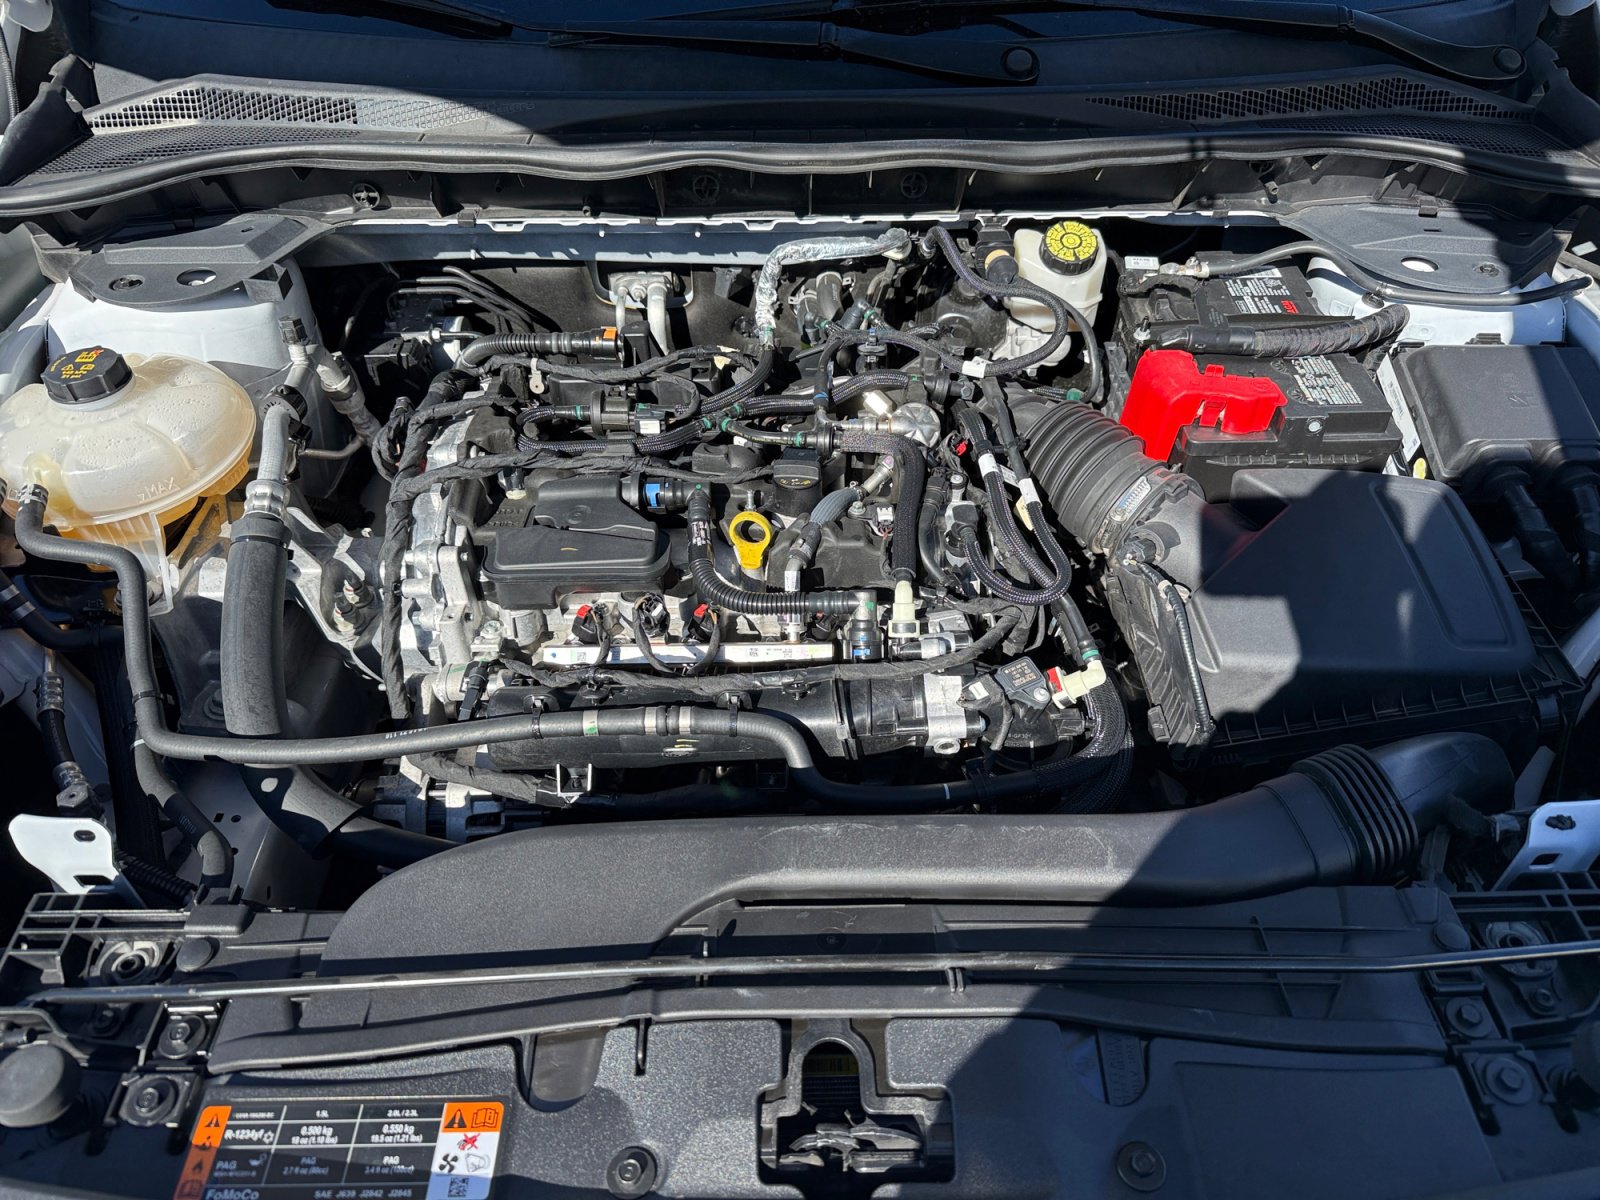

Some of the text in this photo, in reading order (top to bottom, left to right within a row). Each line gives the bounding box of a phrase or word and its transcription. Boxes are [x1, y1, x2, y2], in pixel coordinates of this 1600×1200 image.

[144, 477, 180, 498] MAX
[224, 1129, 265, 1141] R-1234yf
[322, 1125, 333, 1137] kg
[382, 1124, 415, 1135] 0.550 kg
[216, 1160, 238, 1169] PAG
[382, 1155, 400, 1165] PAG
[205, 1188, 260, 1200] FoMoCo
[314, 1190, 333, 1199] SAE
